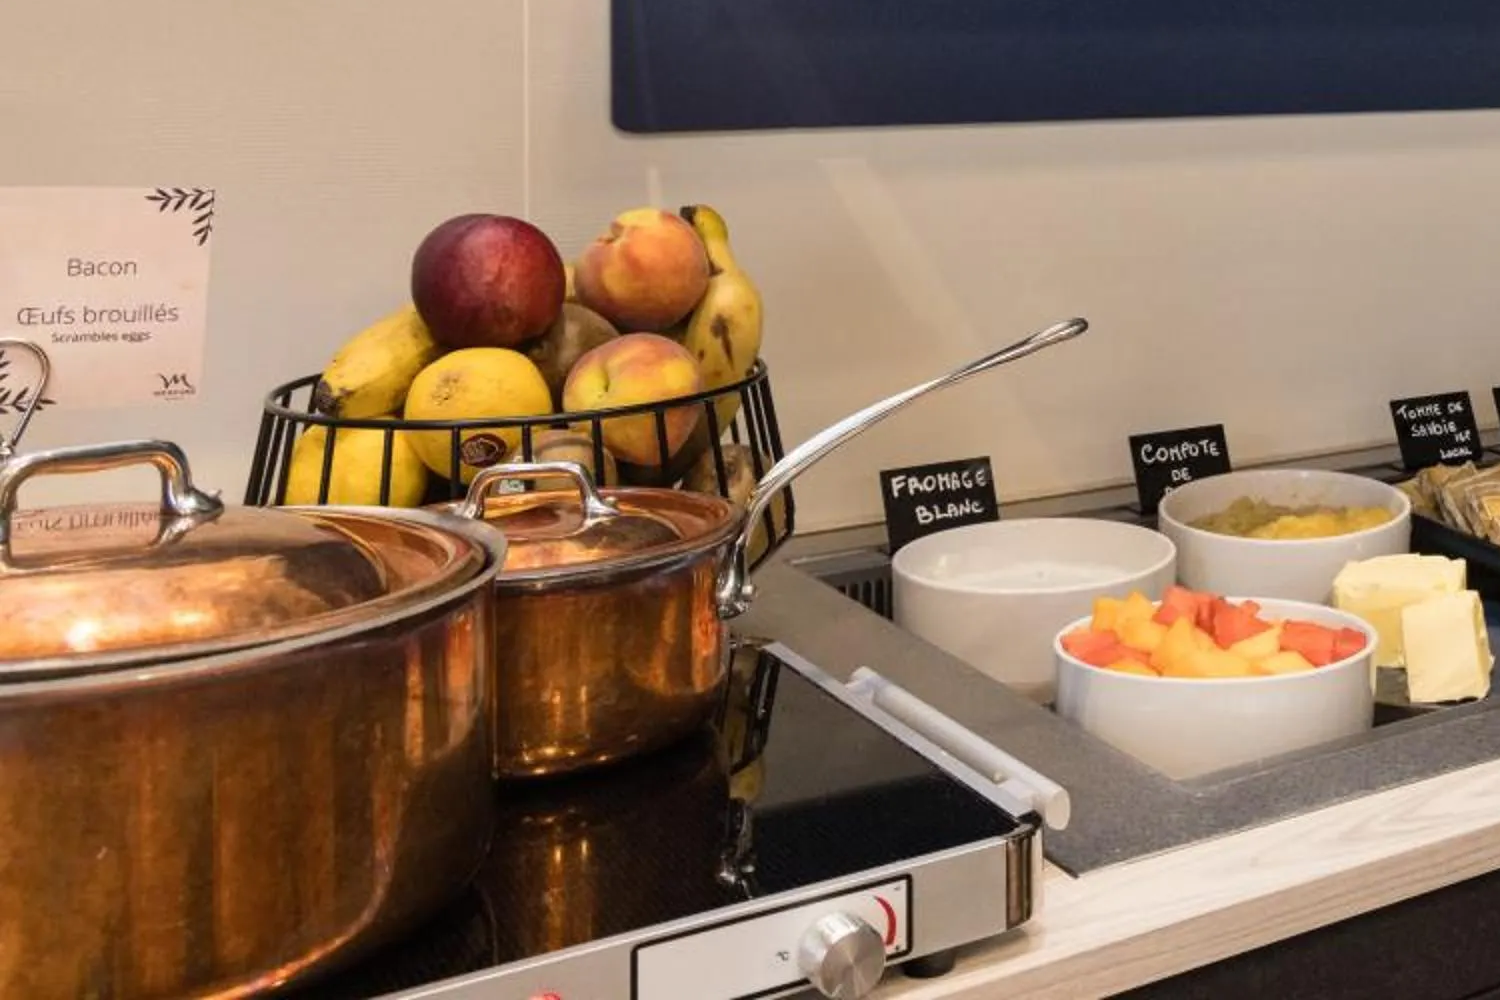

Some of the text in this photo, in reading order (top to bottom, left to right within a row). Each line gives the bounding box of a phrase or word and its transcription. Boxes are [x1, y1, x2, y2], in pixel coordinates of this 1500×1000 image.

[66, 257, 138, 277] Bacon
[16, 303, 180, 326] Œufs brouillés
[51, 331, 152, 344] Scrambles eggs
[1396, 401, 1464, 420] TOMME DE
[1141, 439, 1220, 464] COMPOTE
[1440, 446, 1472, 459] LOCAL
[890, 468, 987, 499] FROMAGE
[1171, 467, 1192, 481] DE
[915, 497, 985, 525] BLANC
